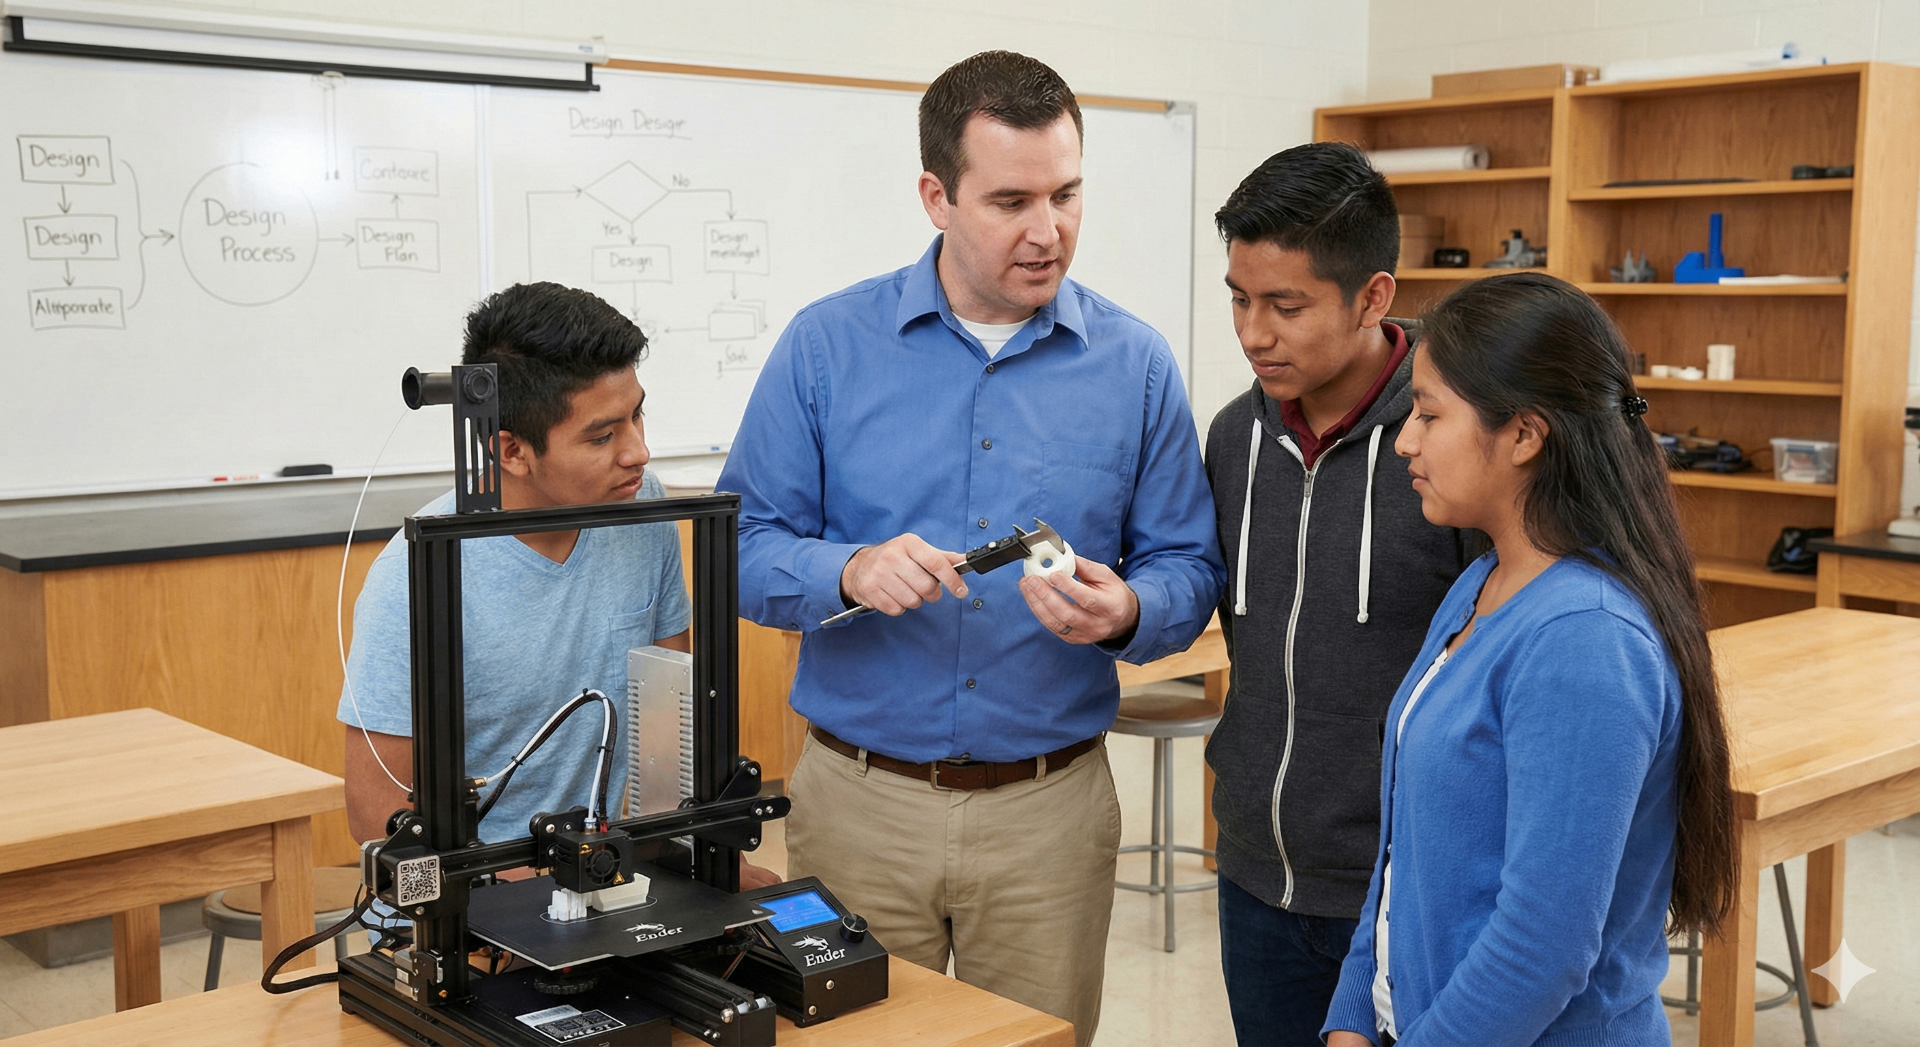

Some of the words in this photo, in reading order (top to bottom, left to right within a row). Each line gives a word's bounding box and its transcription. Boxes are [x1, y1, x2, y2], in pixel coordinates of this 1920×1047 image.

[568, 106, 623, 139] Design
[28, 143, 100, 178] Design
[671, 172, 691, 188] No
[202, 197, 287, 237] Design
[602, 221, 623, 238] Yes
[34, 224, 103, 256] Design
[219, 235, 296, 263] Process
[360, 224, 416, 250] Design
[710, 228, 749, 252] Design
[608, 251, 653, 273] Design
[634, 926, 684, 943] Ender
[803, 948, 847, 968] Ender
